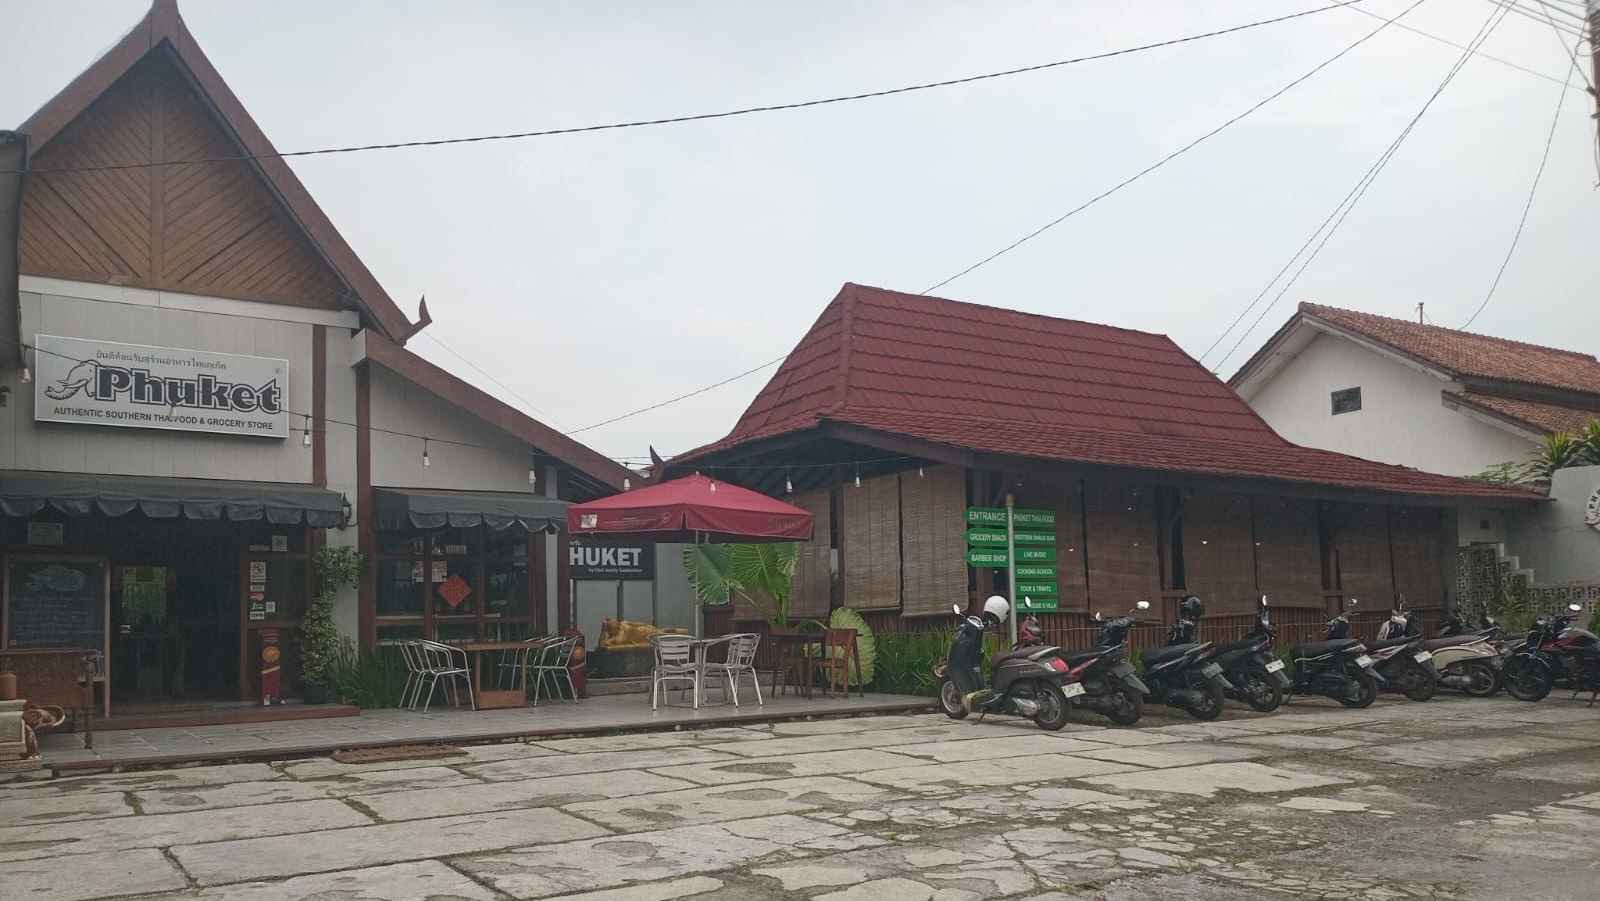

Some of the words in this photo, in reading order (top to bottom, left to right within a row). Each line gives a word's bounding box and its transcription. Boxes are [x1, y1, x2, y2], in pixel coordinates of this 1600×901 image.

[95, 366, 281, 415] Phuket
[54, 406, 104, 418] AUTHENTIC
[105, 410, 152, 421] SOUTHERN
[154, 413, 172, 423] THA
[199, 417, 206, 425] &
[207, 418, 245, 428] GROCERY
[247, 421, 273, 430] STORE
[969, 511, 1007, 522] ENTRANCE
[569, 546, 642, 566] HUKET
[971, 553, 992, 562] BARBER
[993, 554, 1007, 562] SHOP
